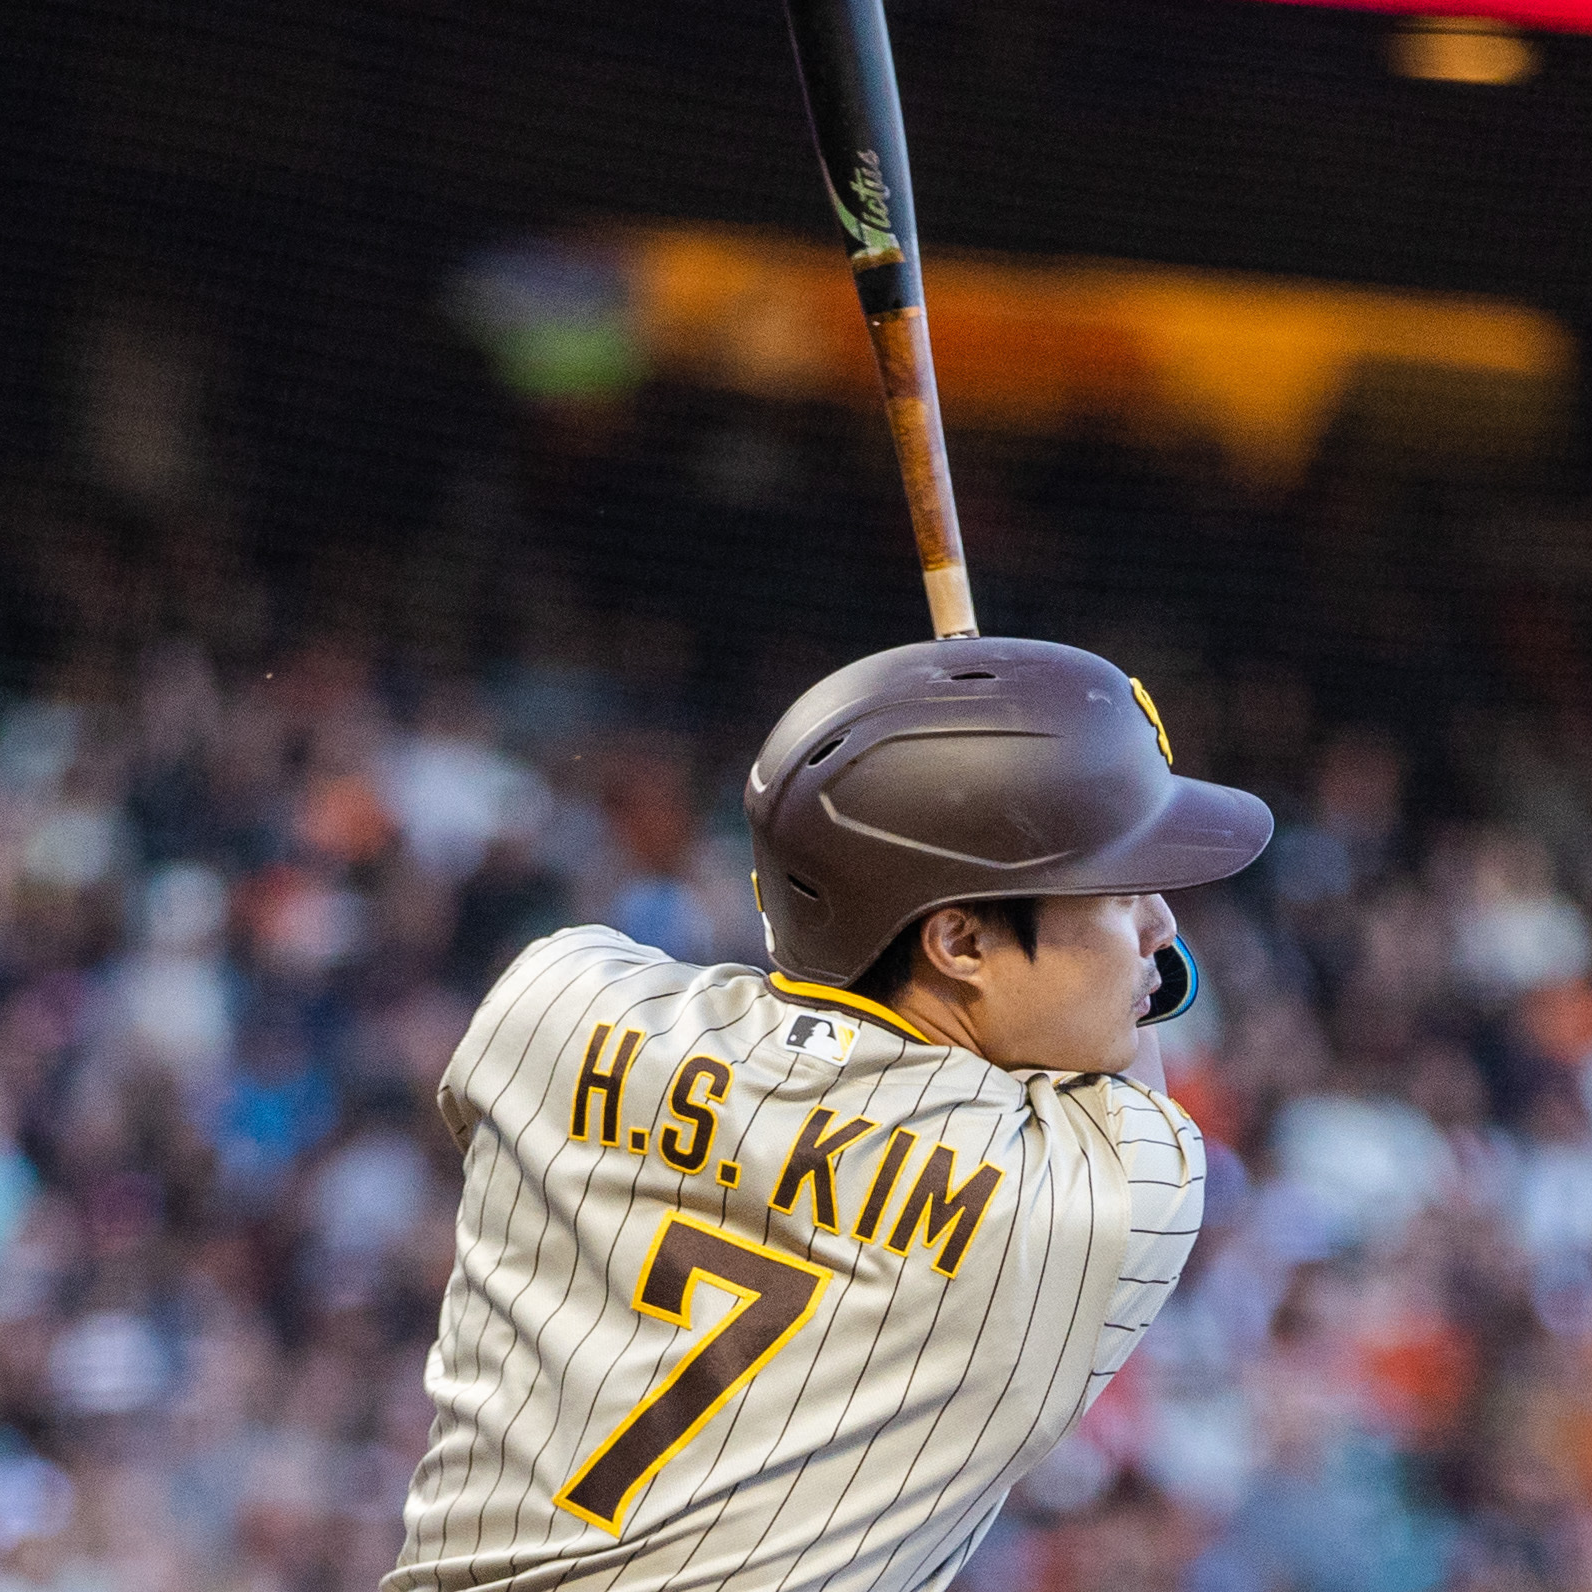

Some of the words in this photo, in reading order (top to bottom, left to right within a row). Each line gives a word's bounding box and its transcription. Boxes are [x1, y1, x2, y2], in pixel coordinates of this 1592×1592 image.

[833, 148, 903, 262] Victus
[569, 1022, 742, 1190] H.S.
[768, 1105, 1007, 1280] KIM
[553, 1208, 834, 1538] 7
